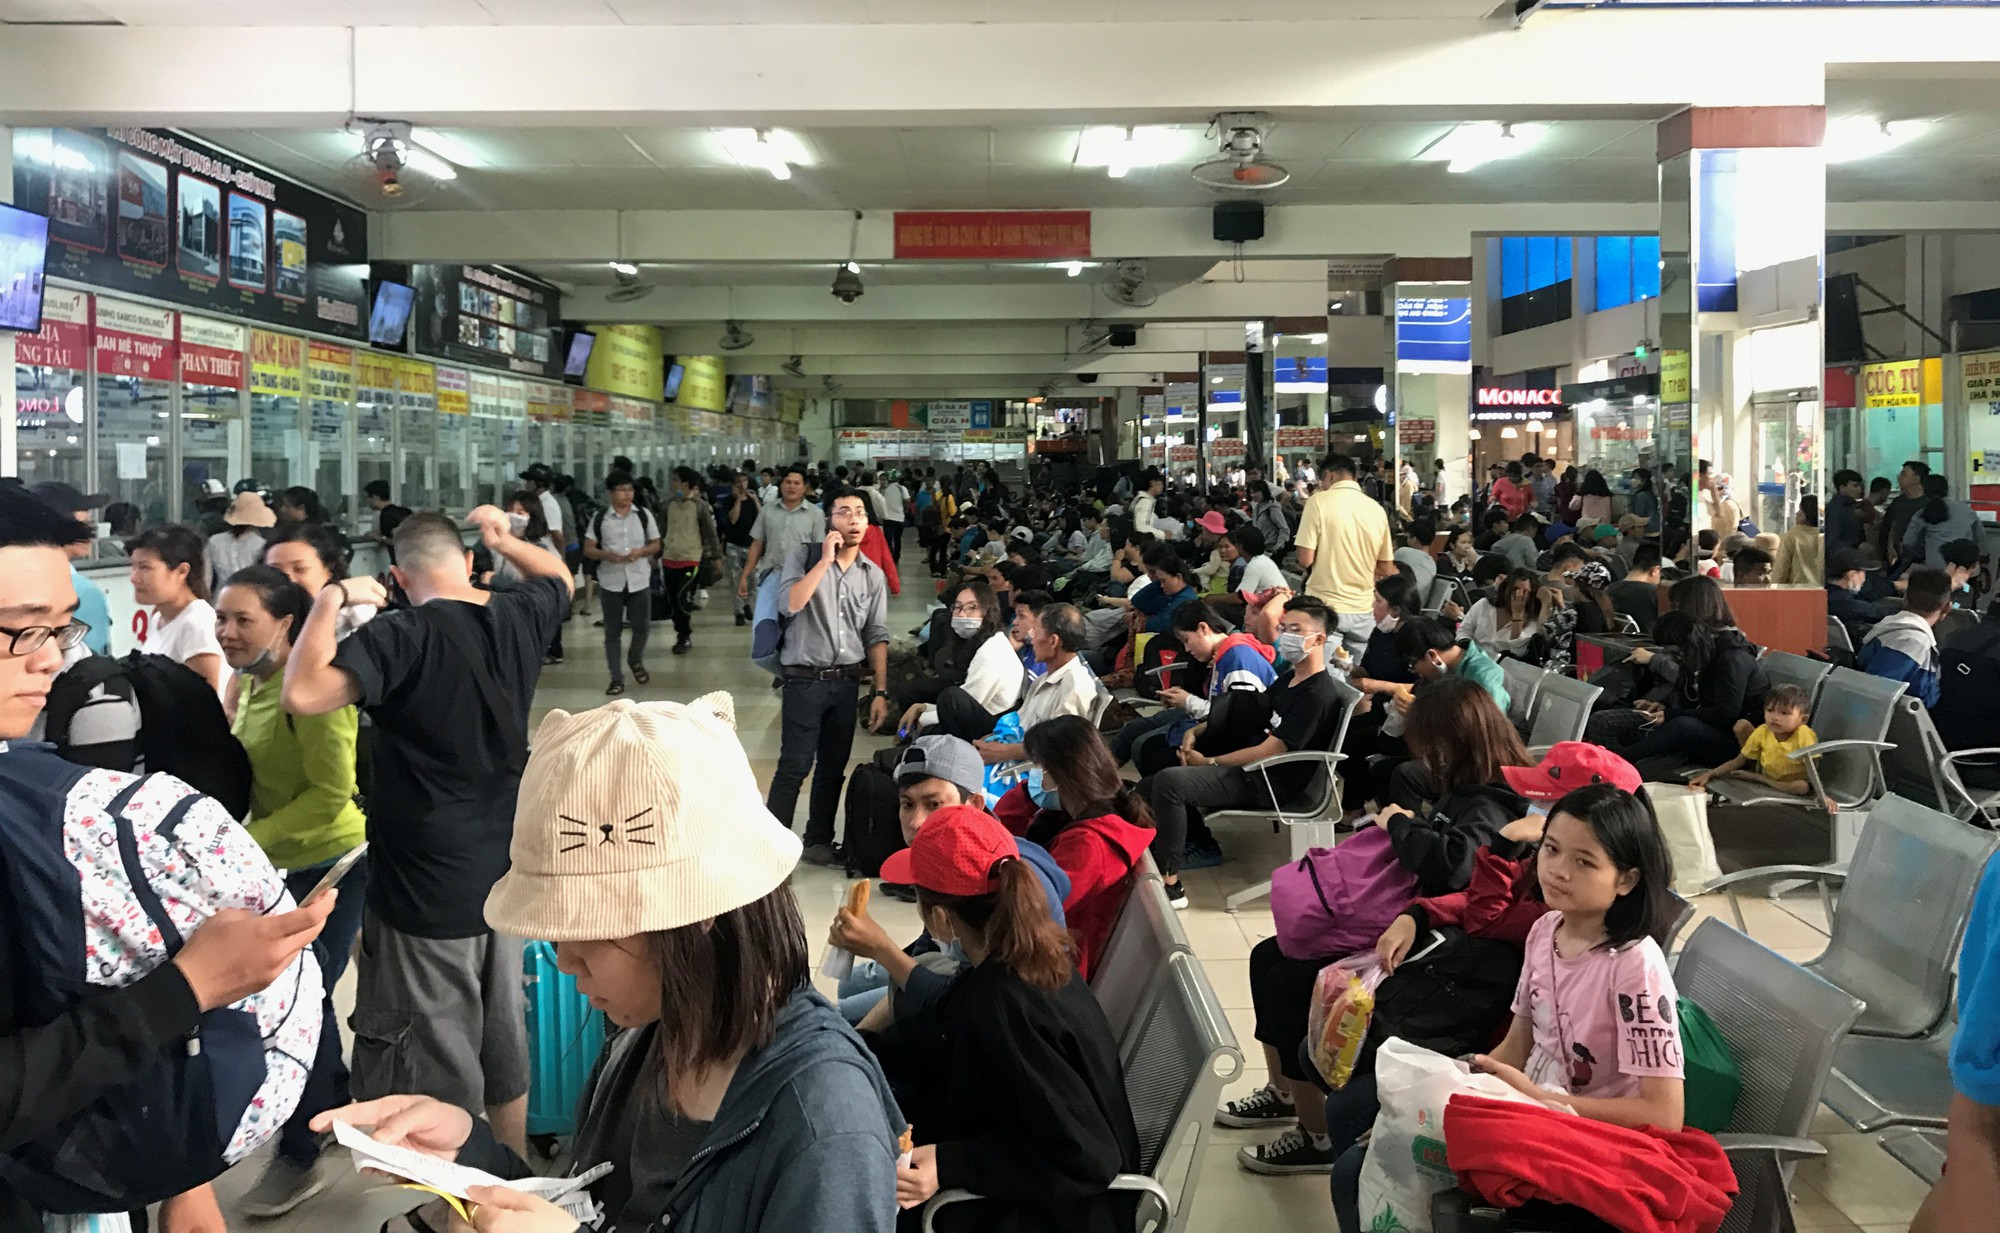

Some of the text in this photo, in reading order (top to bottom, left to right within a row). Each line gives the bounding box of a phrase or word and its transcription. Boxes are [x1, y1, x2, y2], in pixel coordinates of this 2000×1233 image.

[97, 334, 116, 351] BAN
[44, 344, 72, 366] TÀU
[180, 352, 240, 378] PHAN THIẾT
[1864, 366, 1895, 396] CÚC
